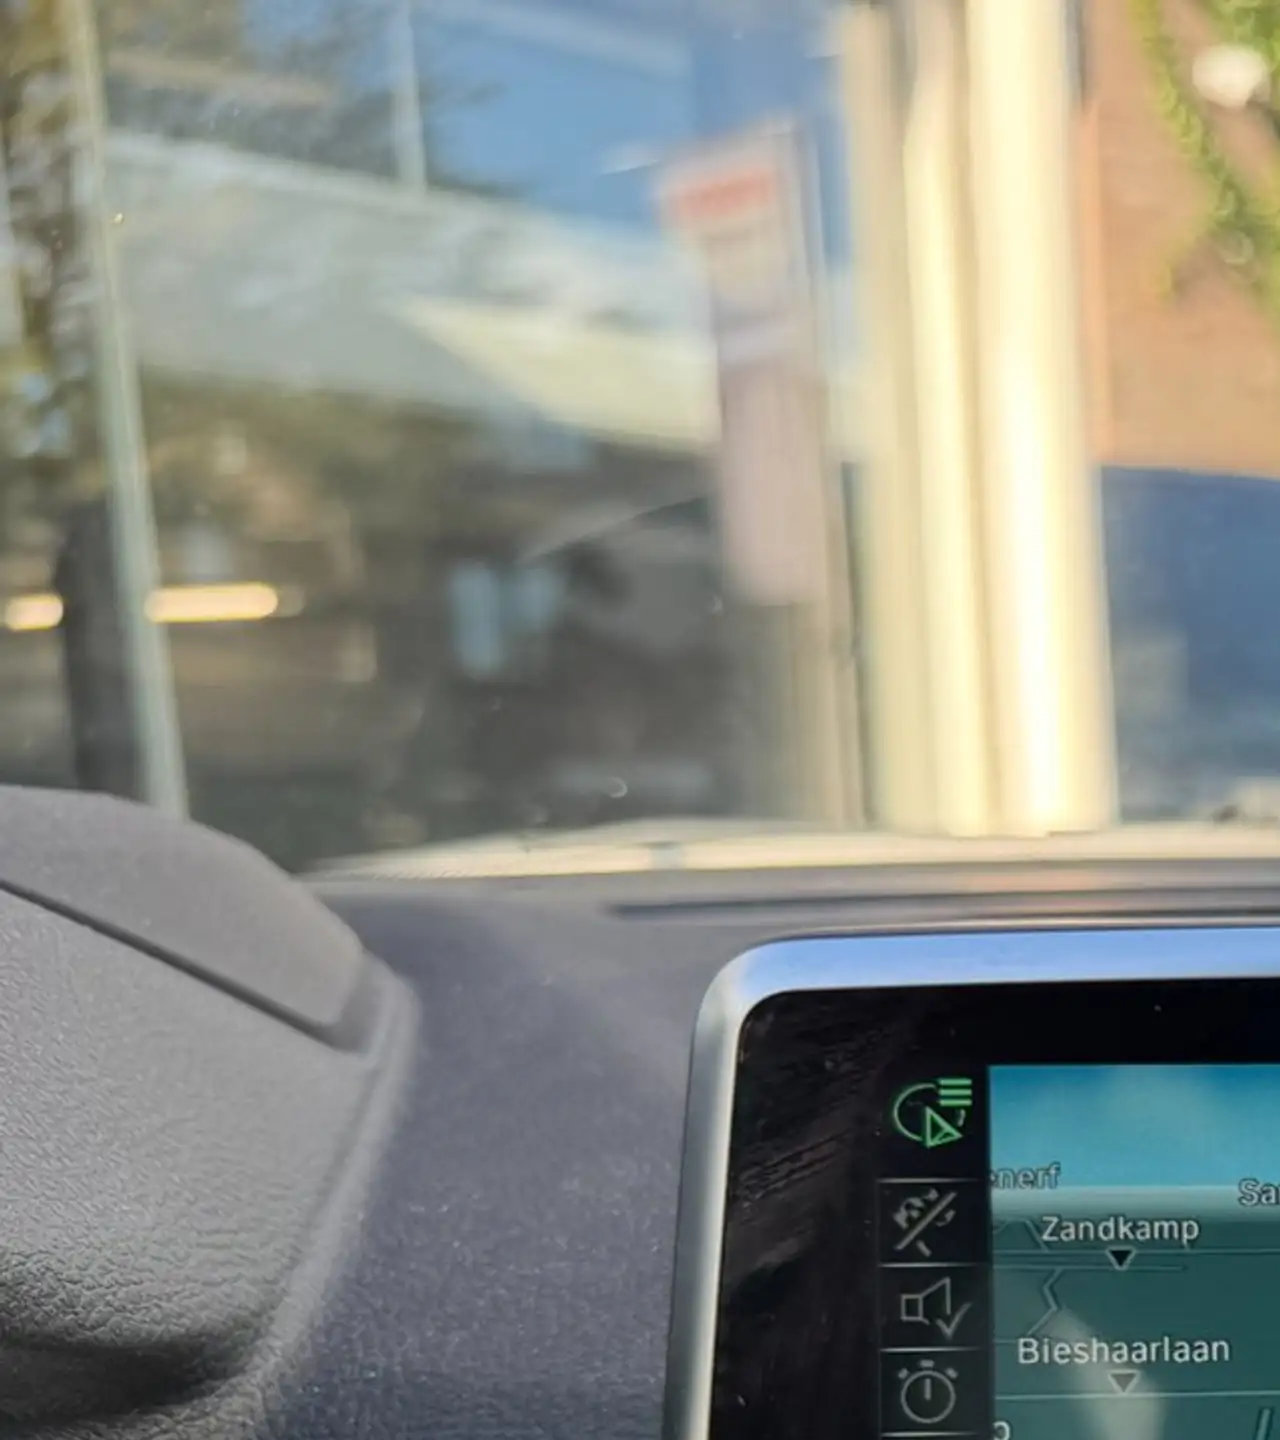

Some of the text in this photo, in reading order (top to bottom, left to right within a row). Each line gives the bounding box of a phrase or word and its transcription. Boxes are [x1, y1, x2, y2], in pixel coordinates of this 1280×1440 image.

[990, 1162, 1061, 1189] nerf
[1041, 1216, 1200, 1248] Zandkamp
[1017, 1336, 1231, 1365] Bieshaarlaan
